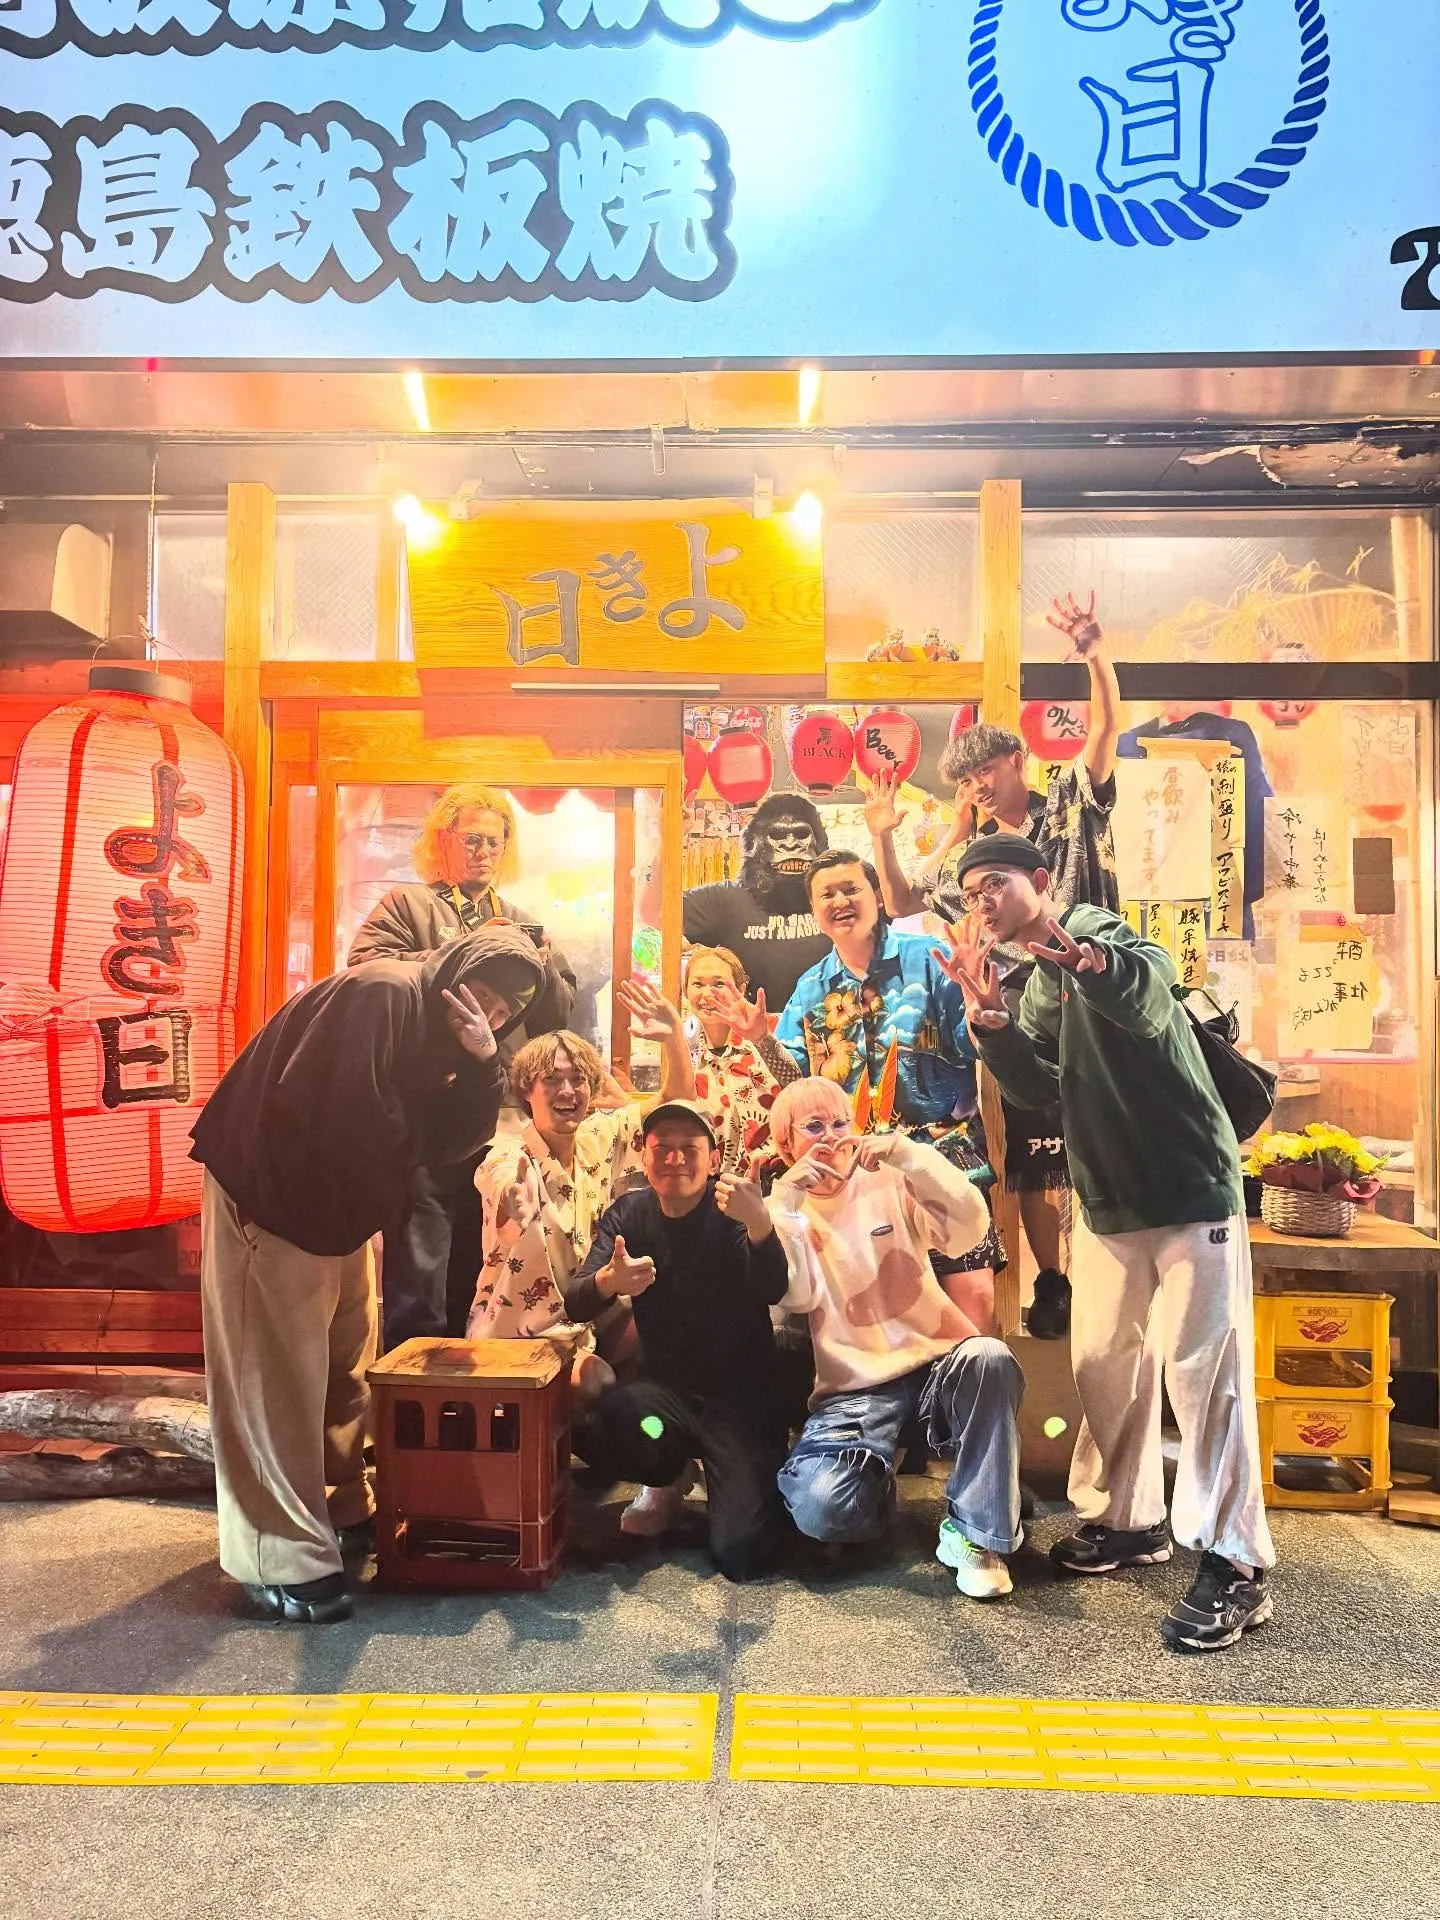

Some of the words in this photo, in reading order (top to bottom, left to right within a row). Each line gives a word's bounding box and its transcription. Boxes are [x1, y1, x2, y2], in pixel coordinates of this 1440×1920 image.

[488, 519, 747, 666] よき日
[803, 747, 847, 760] BLACK
[866, 728, 904, 771] Beer
[1162, 767, 1183, 824] 昼飲み
[98, 760, 211, 1109] よき日
[744, 925, 775, 940] JUST
[1027, 1137, 1064, 1156] アサ
